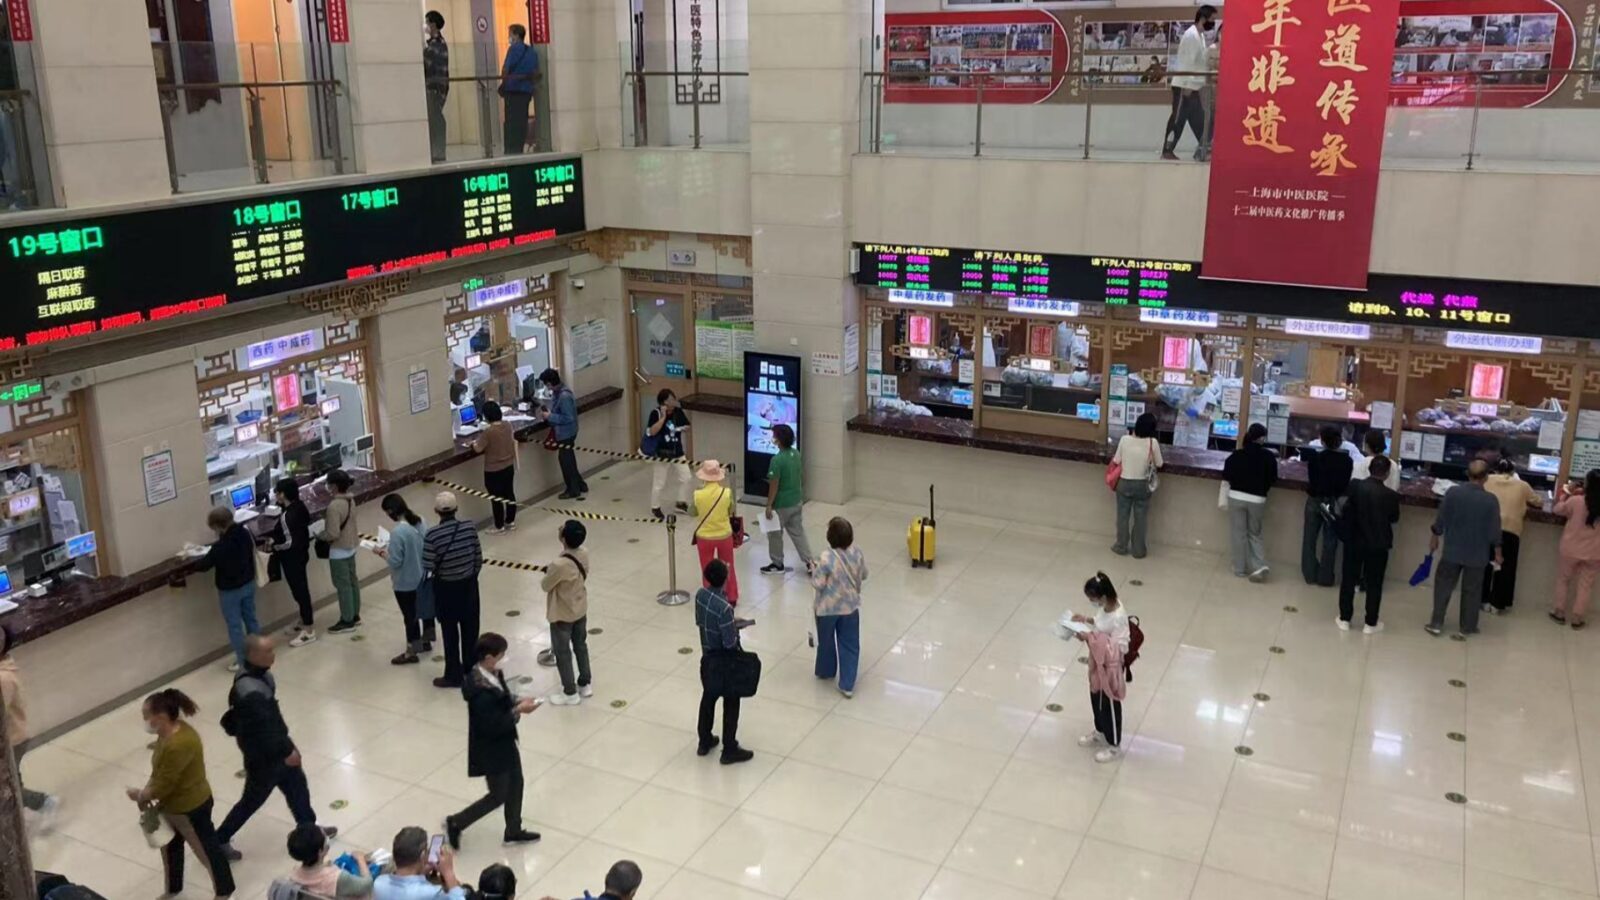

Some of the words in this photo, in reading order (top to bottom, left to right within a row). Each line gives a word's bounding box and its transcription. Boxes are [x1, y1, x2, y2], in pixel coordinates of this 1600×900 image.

[463, 172, 509, 193] 16号窗口
[535, 164, 575, 185] 15号窗口
[341, 187, 398, 211] 17号窗口
[1249, 186, 1329, 201] 上海市中医医院
[233, 200, 301, 226] 18号窗口
[8, 226, 103, 257] 19号窗口
[974, 250, 1043, 263] 请下列人员取药
[37, 296, 96, 318] 互联网取药
[1148, 309, 1210, 323] 中草药发药
[1292, 320, 1364, 336] 外送代煎办理
[252, 342, 274, 358] 西药
[278, 334, 311, 350] 中成药
[1453, 333, 1535, 349] 外送代煎办理
[1477, 404, 1490, 413] 10
[18, 496, 31, 509] 19
